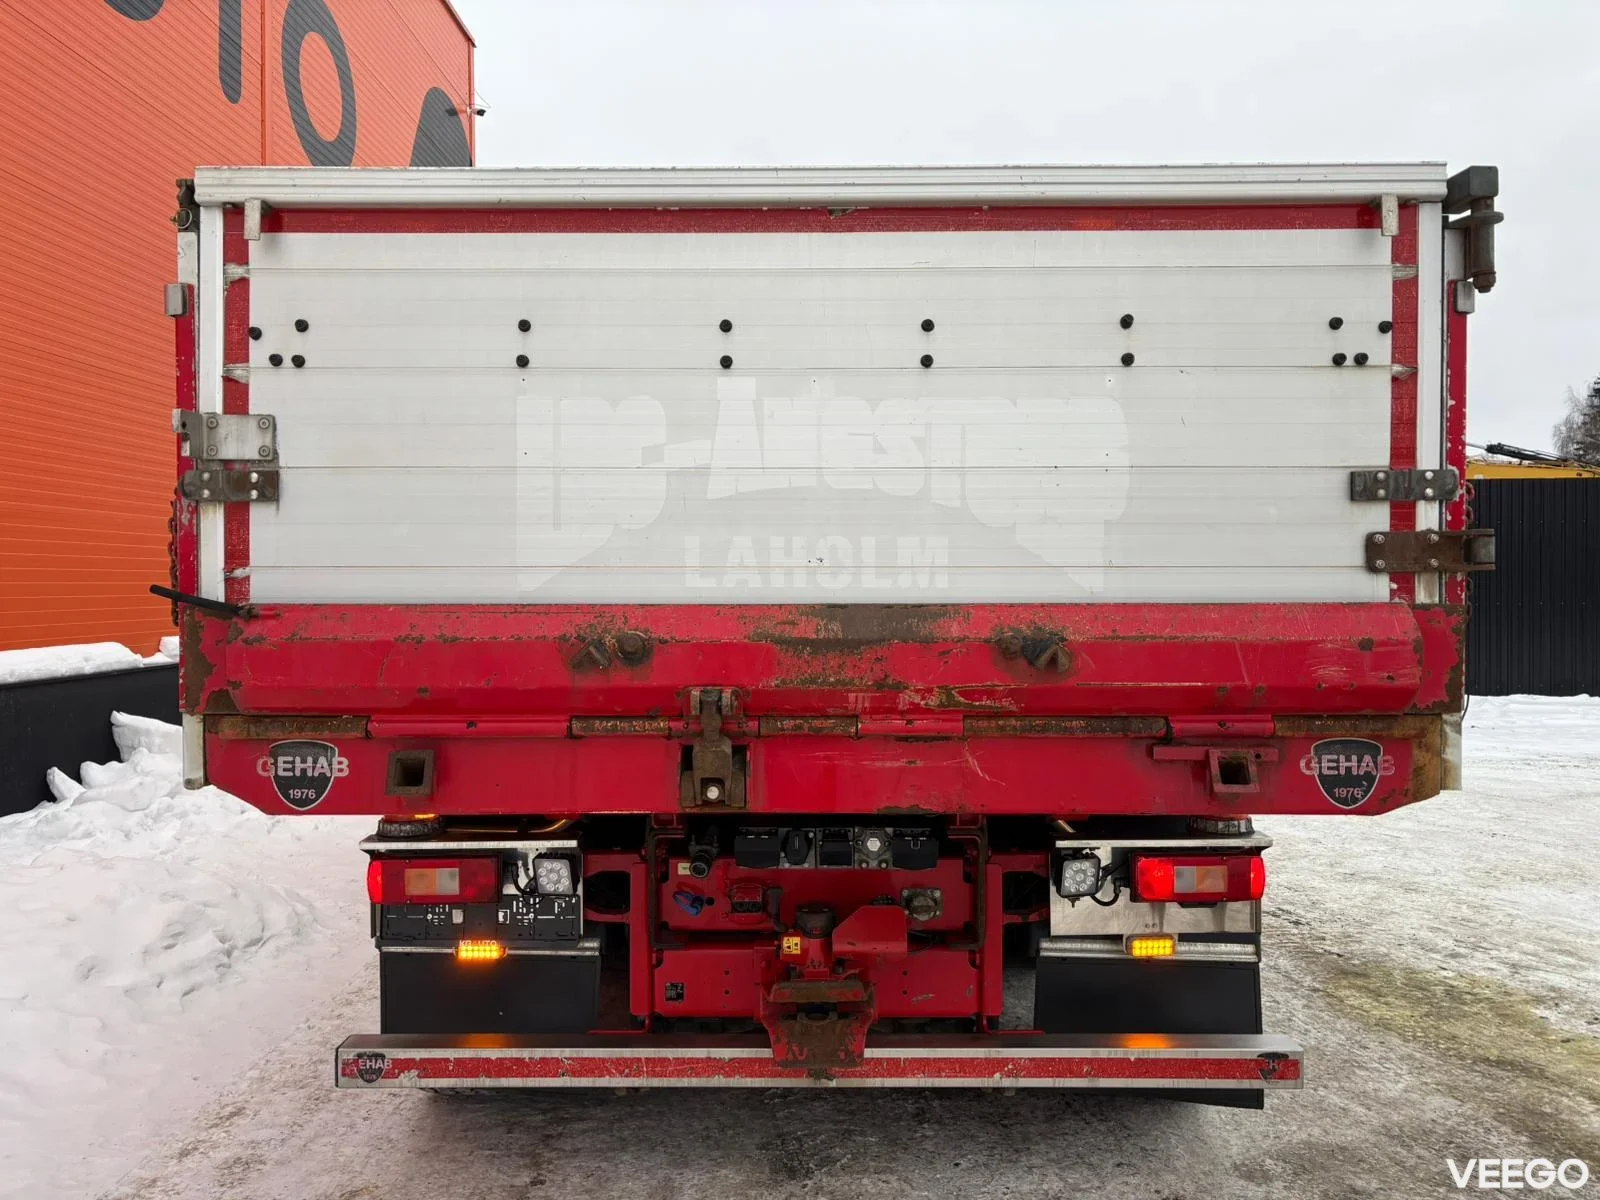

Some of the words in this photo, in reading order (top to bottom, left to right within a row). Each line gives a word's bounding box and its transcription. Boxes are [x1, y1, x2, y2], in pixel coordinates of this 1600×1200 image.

[684, 535, 950, 588] LAHOLM
[256, 755, 350, 777] GEHAB
[1299, 754, 1396, 776] GEHAB
[288, 788, 317, 800] 1976
[1333, 787, 1362, 798] 1976
[350, 1058, 393, 1070] EHAB
